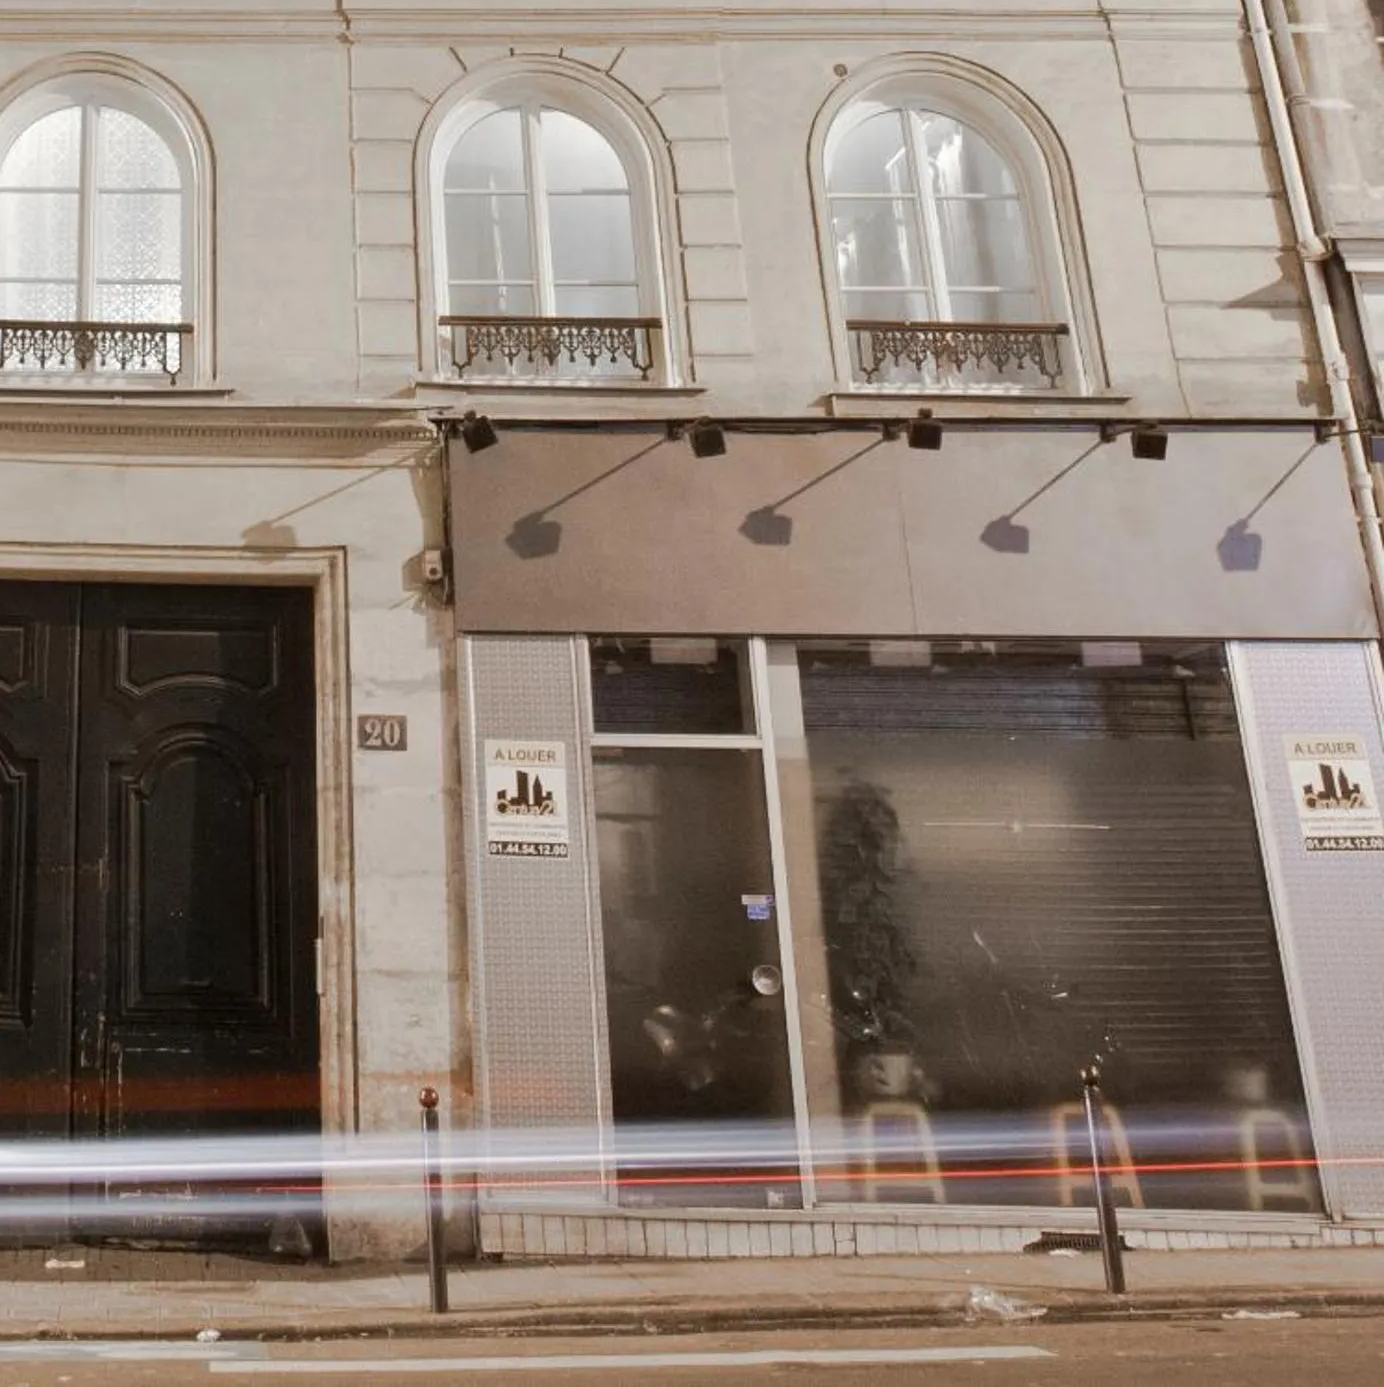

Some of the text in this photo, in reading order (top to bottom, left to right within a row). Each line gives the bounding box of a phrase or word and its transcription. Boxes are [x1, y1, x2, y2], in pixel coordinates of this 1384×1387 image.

[364, 719, 400, 747] 20
[1307, 742, 1358, 755] LOUER
[507, 749, 556, 762] LOUER
